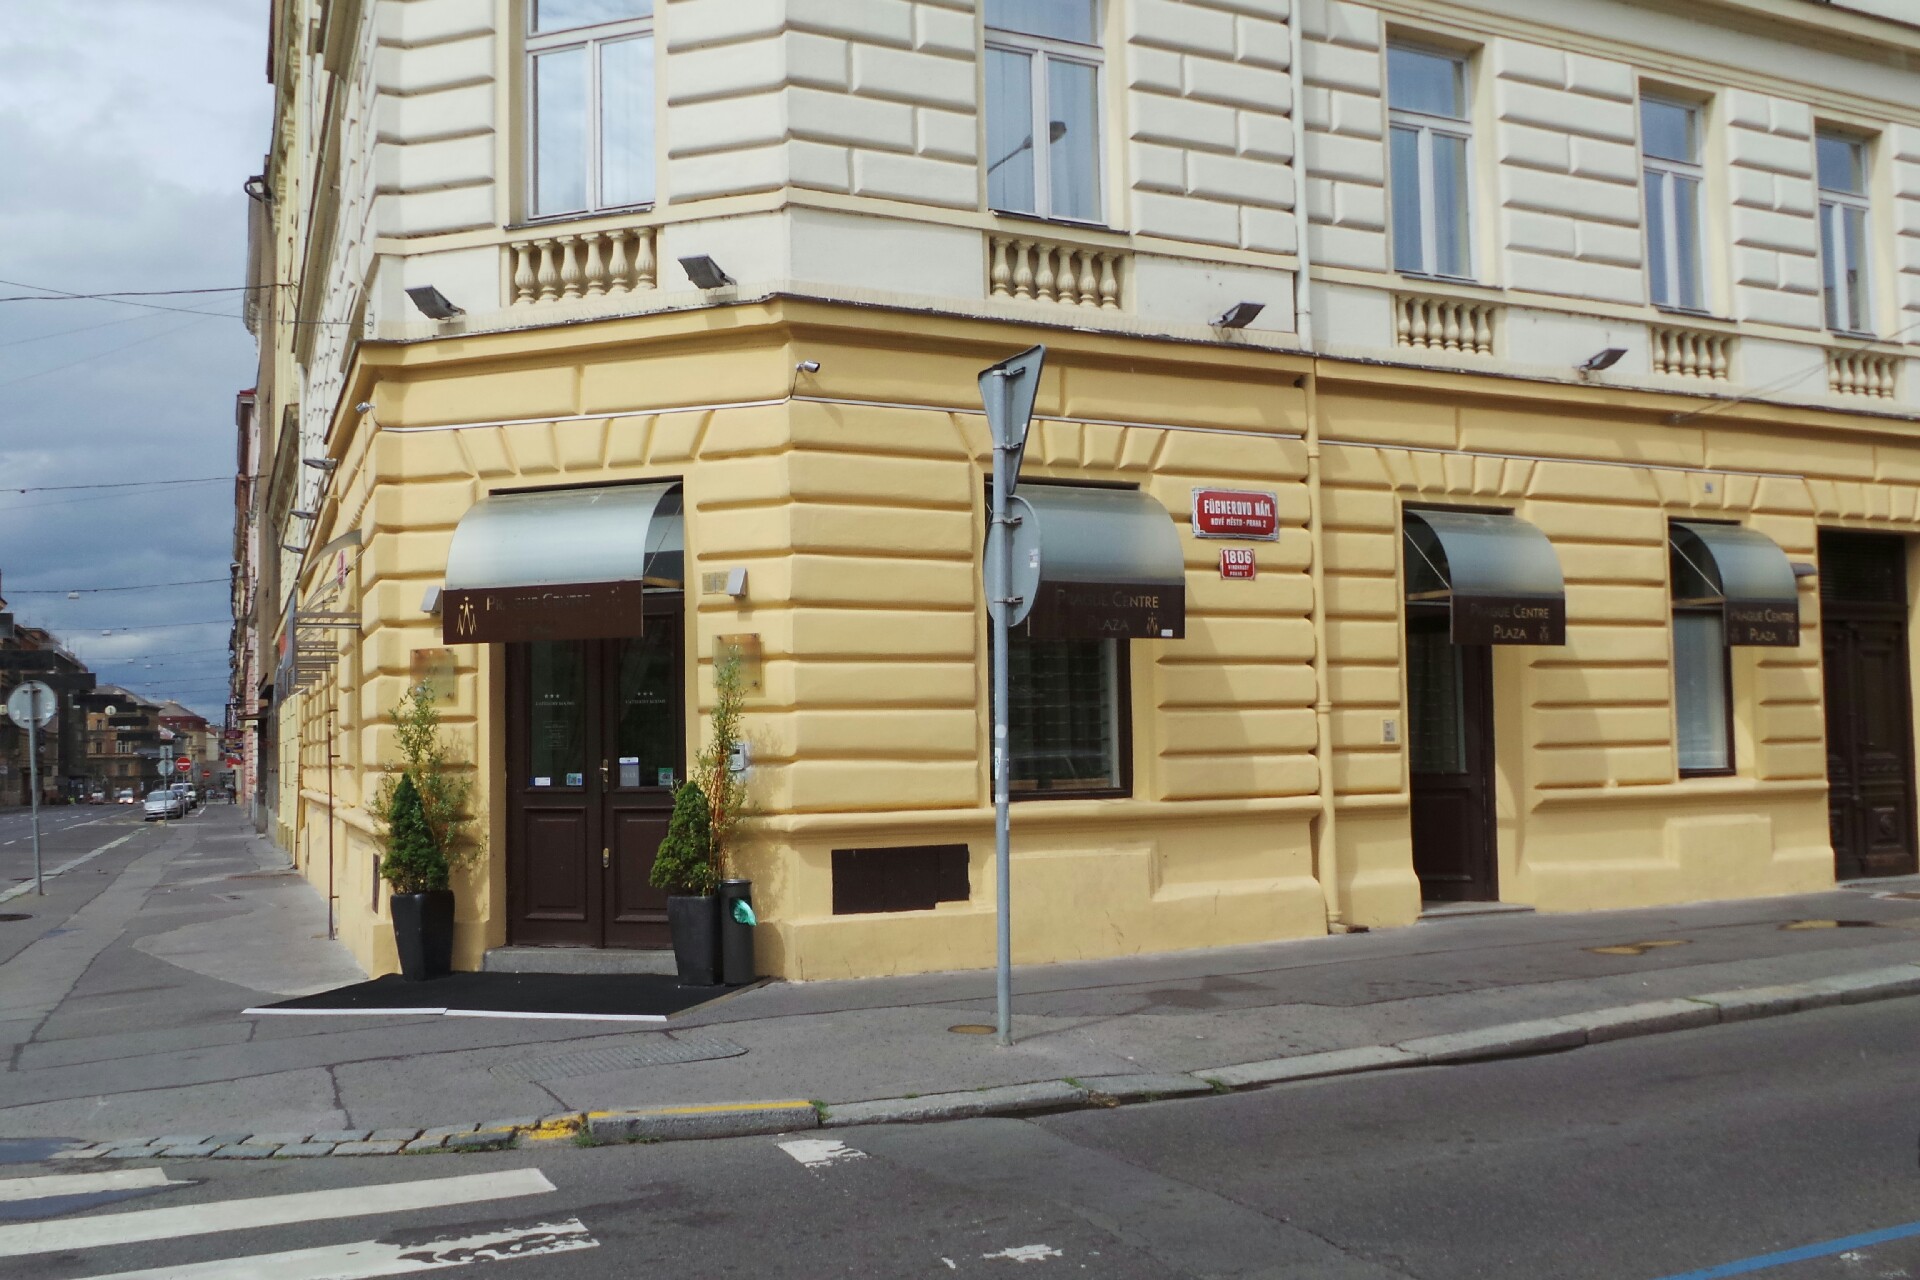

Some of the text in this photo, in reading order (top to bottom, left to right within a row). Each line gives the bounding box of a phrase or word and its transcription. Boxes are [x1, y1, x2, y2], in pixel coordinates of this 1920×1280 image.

[1204, 499, 1273, 517] FÜGNEROVO NÁM.
[1210, 517, 1225, 526] NOVÉ
[1262, 519, 1267, 529] 2
[1224, 550, 1251, 564] 1806
[1112, 590, 1159, 608] CENTRE
[1513, 603, 1549, 619] CENTRE
[1493, 624, 1527, 640] PLAZA
[1749, 627, 1777, 641] PLAZA
